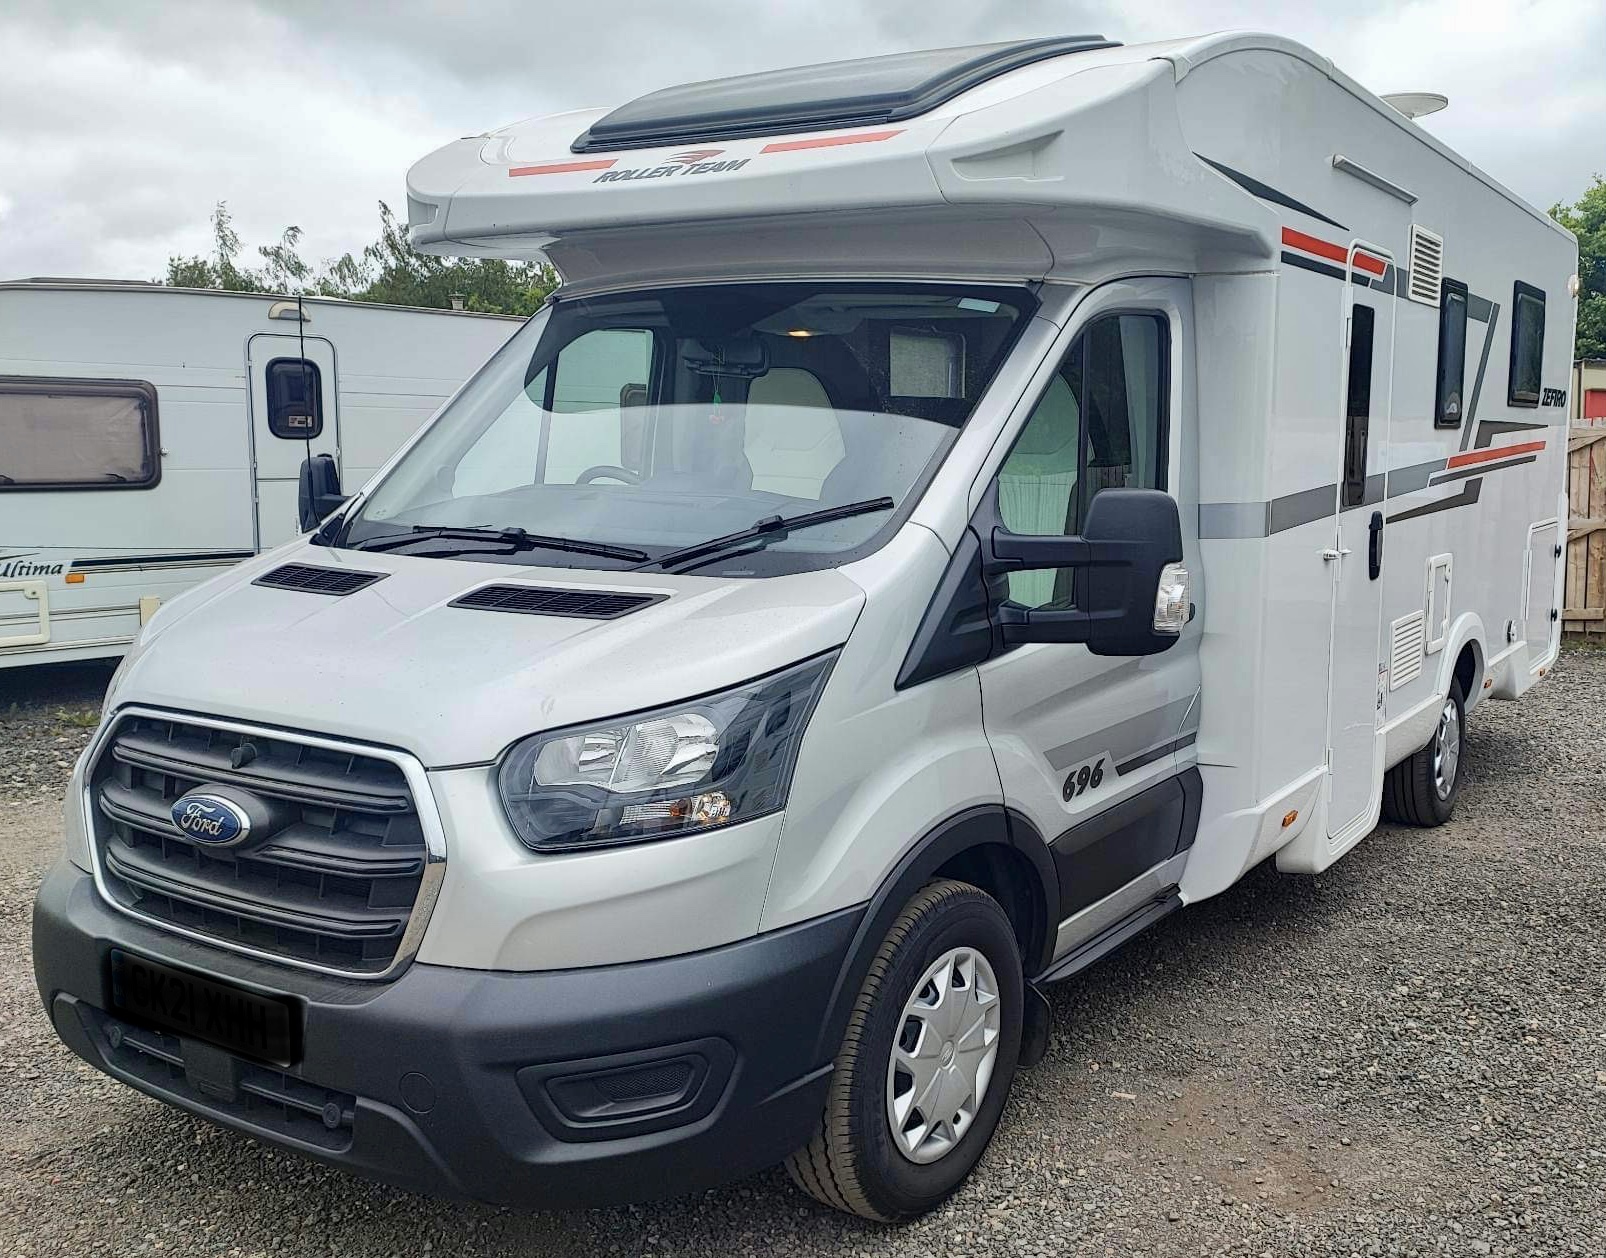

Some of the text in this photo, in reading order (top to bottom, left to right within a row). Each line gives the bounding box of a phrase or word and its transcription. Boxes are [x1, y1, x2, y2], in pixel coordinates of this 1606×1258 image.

[592, 158, 752, 184] ROLLER TEAM
[1541, 387, 1567, 408] ZEFIRO
[1062, 757, 1106, 803] 696
[180, 802, 225, 836] Ford
